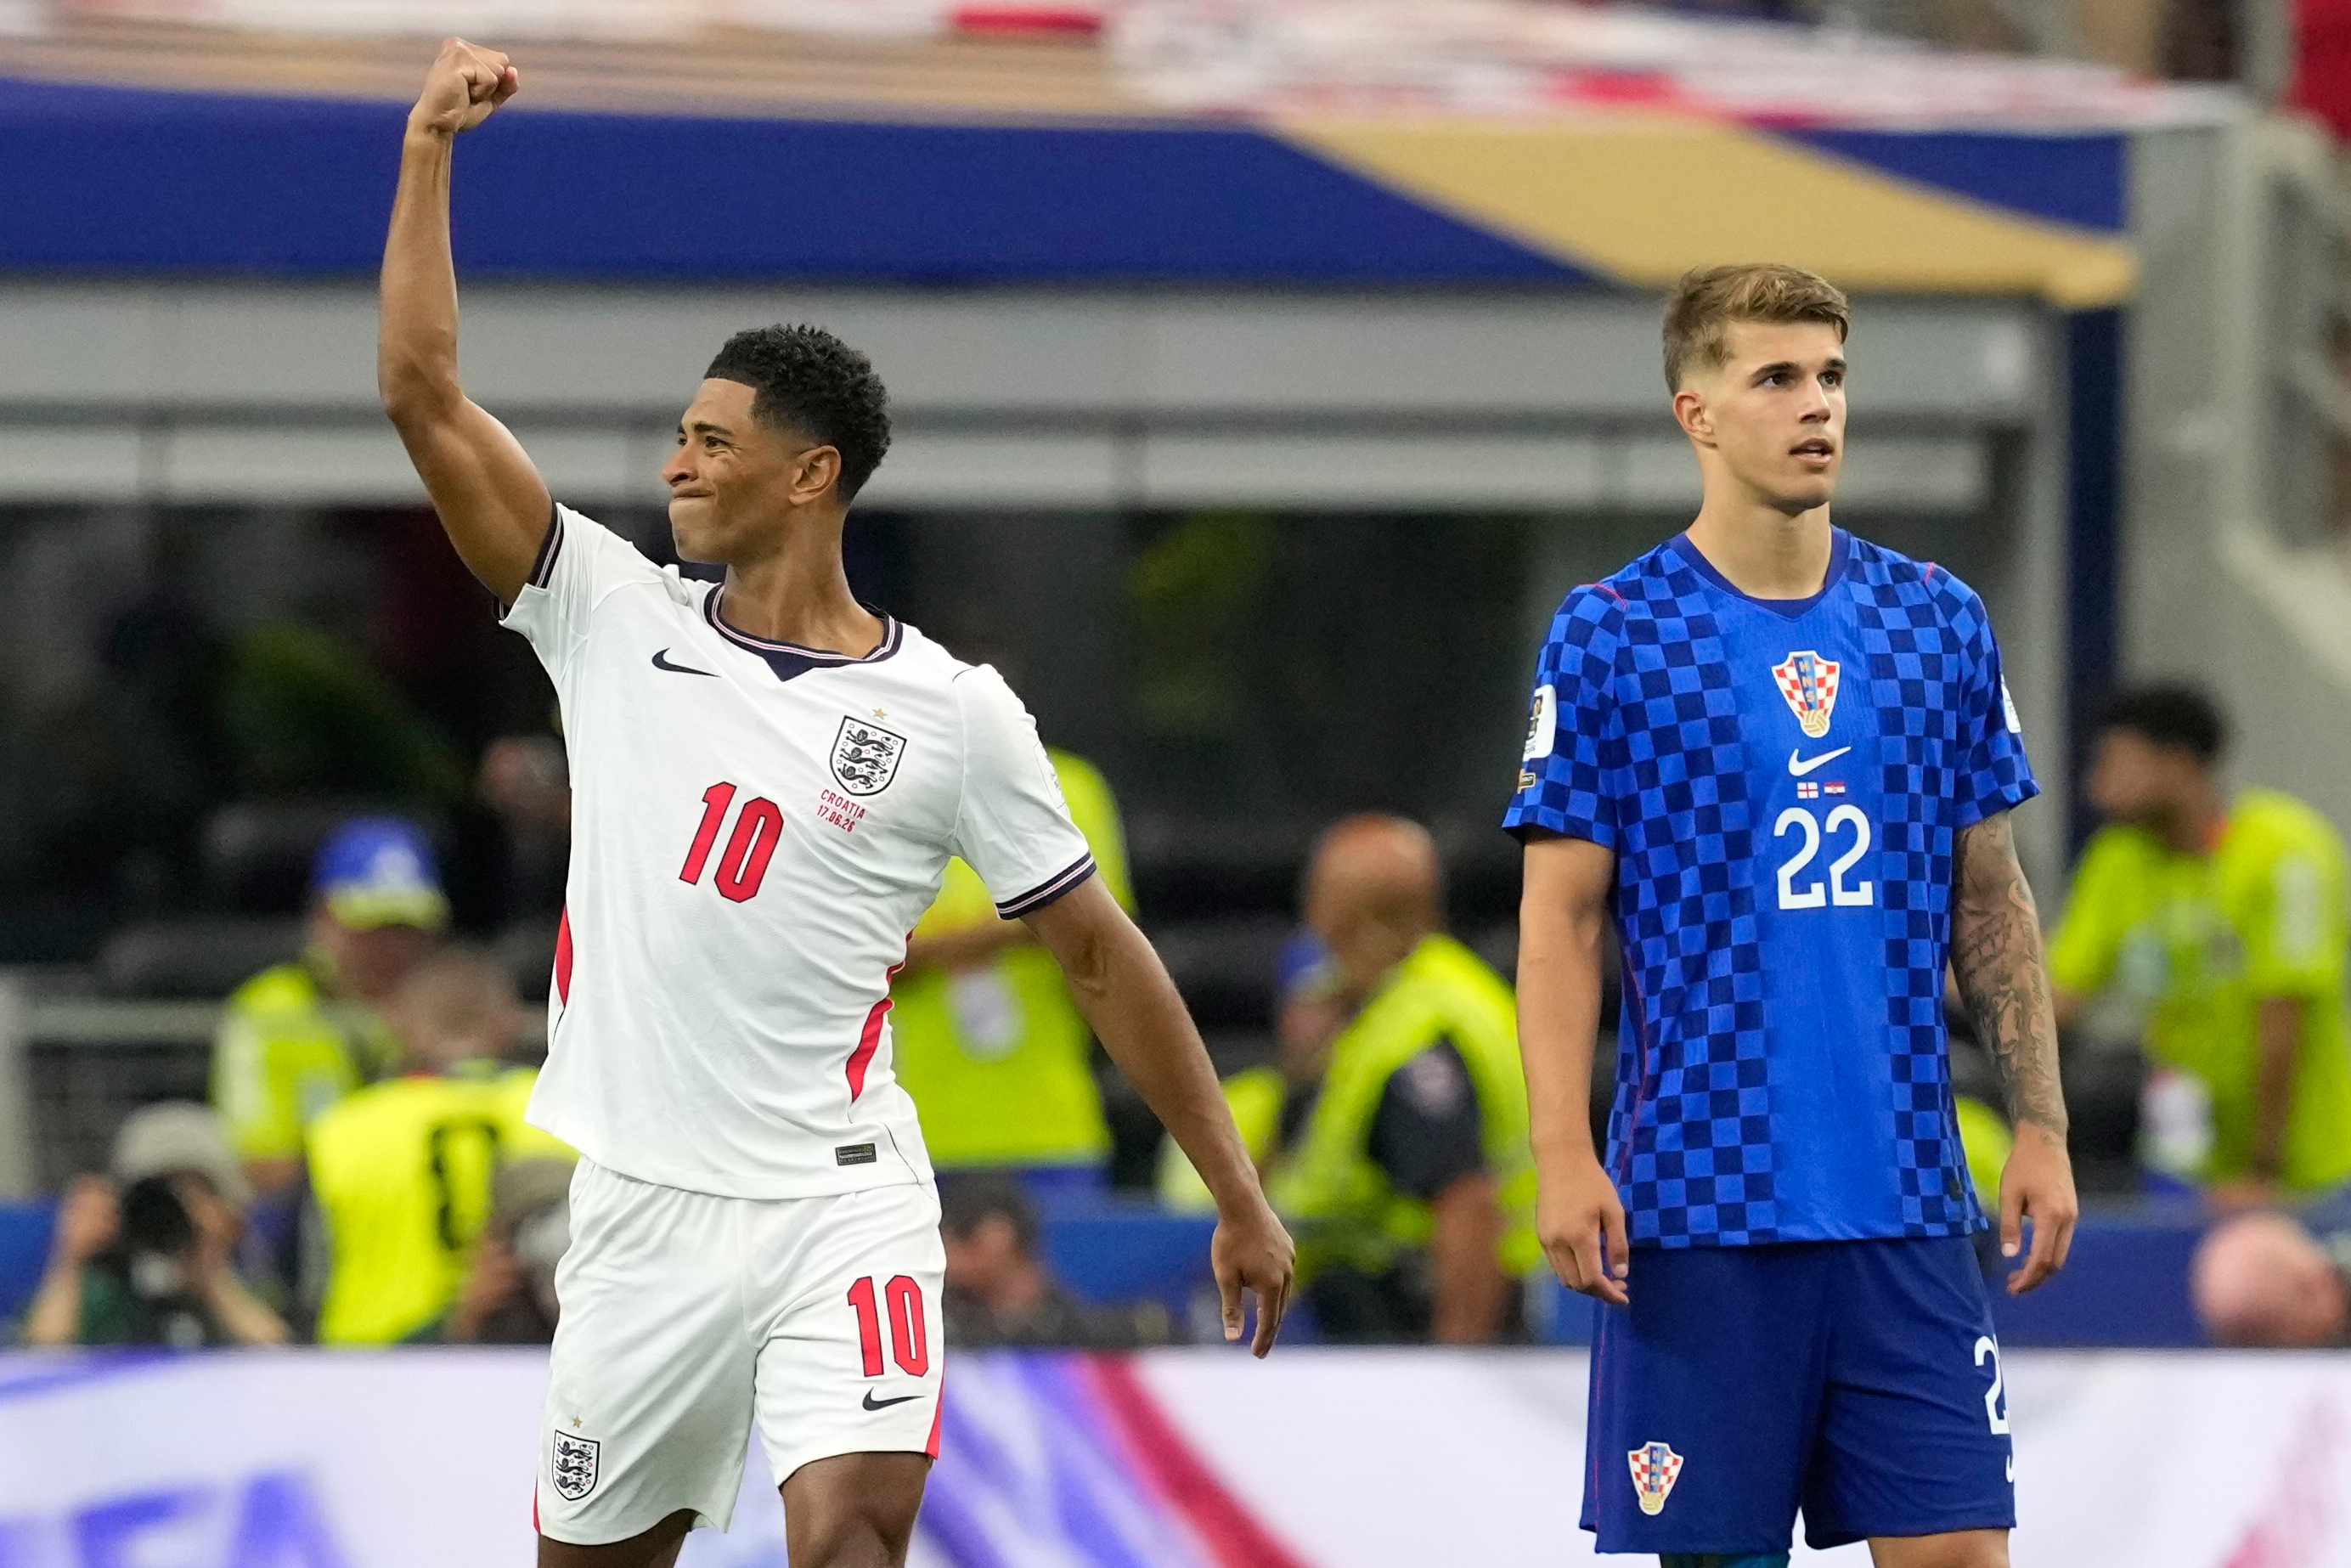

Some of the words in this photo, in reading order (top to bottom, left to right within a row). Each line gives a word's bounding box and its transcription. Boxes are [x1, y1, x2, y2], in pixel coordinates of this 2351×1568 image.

[679, 781, 784, 903] 10
[817, 804, 855, 832] 17.06.26
[820, 789, 865, 820] CROATIA
[1773, 804, 1874, 910] 22
[847, 1274, 929, 1377] 10
[1974, 1334, 2011, 1435] 2
